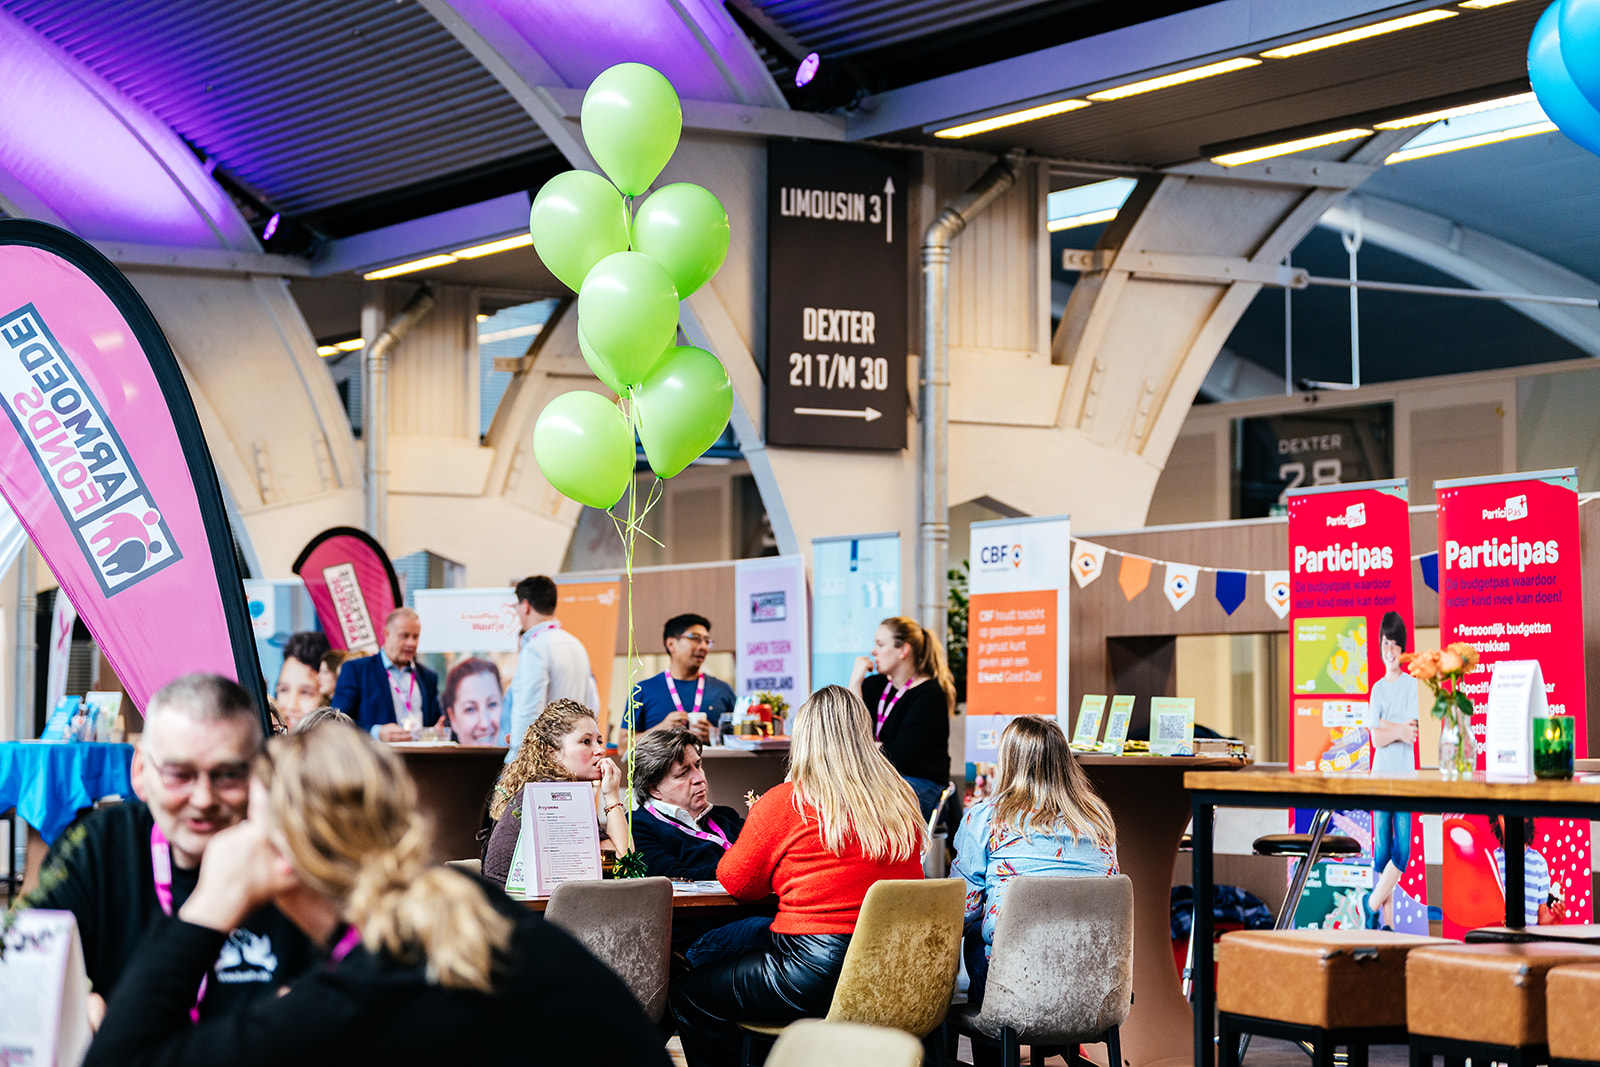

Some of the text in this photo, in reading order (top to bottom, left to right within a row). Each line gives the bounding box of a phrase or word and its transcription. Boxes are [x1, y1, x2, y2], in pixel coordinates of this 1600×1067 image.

[781, 187, 882, 224] LIMOUSIN 3
[803, 307, 876, 344] DEXTER
[789, 353, 888, 391] 21 T/M 30
[1278, 434, 1342, 455] DEXTER
[981, 545, 1008, 564] CBF
[1294, 542, 1393, 576] Participas
[1445, 536, 1559, 572] Participas
[1308, 580, 1351, 594] budgetpas
[1353, 579, 1391, 590] waardoor
[1446, 573, 1557, 592] Dé budgetpas waardoor
[1295, 594, 1396, 609] ieder kind mee kan doen!
[1446, 590, 1562, 607] ieder kind mee kan doen!
[979, 610, 994, 622] CBF
[1458, 622, 1551, 638] Persoonlijk budgetten
[1025, 670, 1042, 682] Doel
